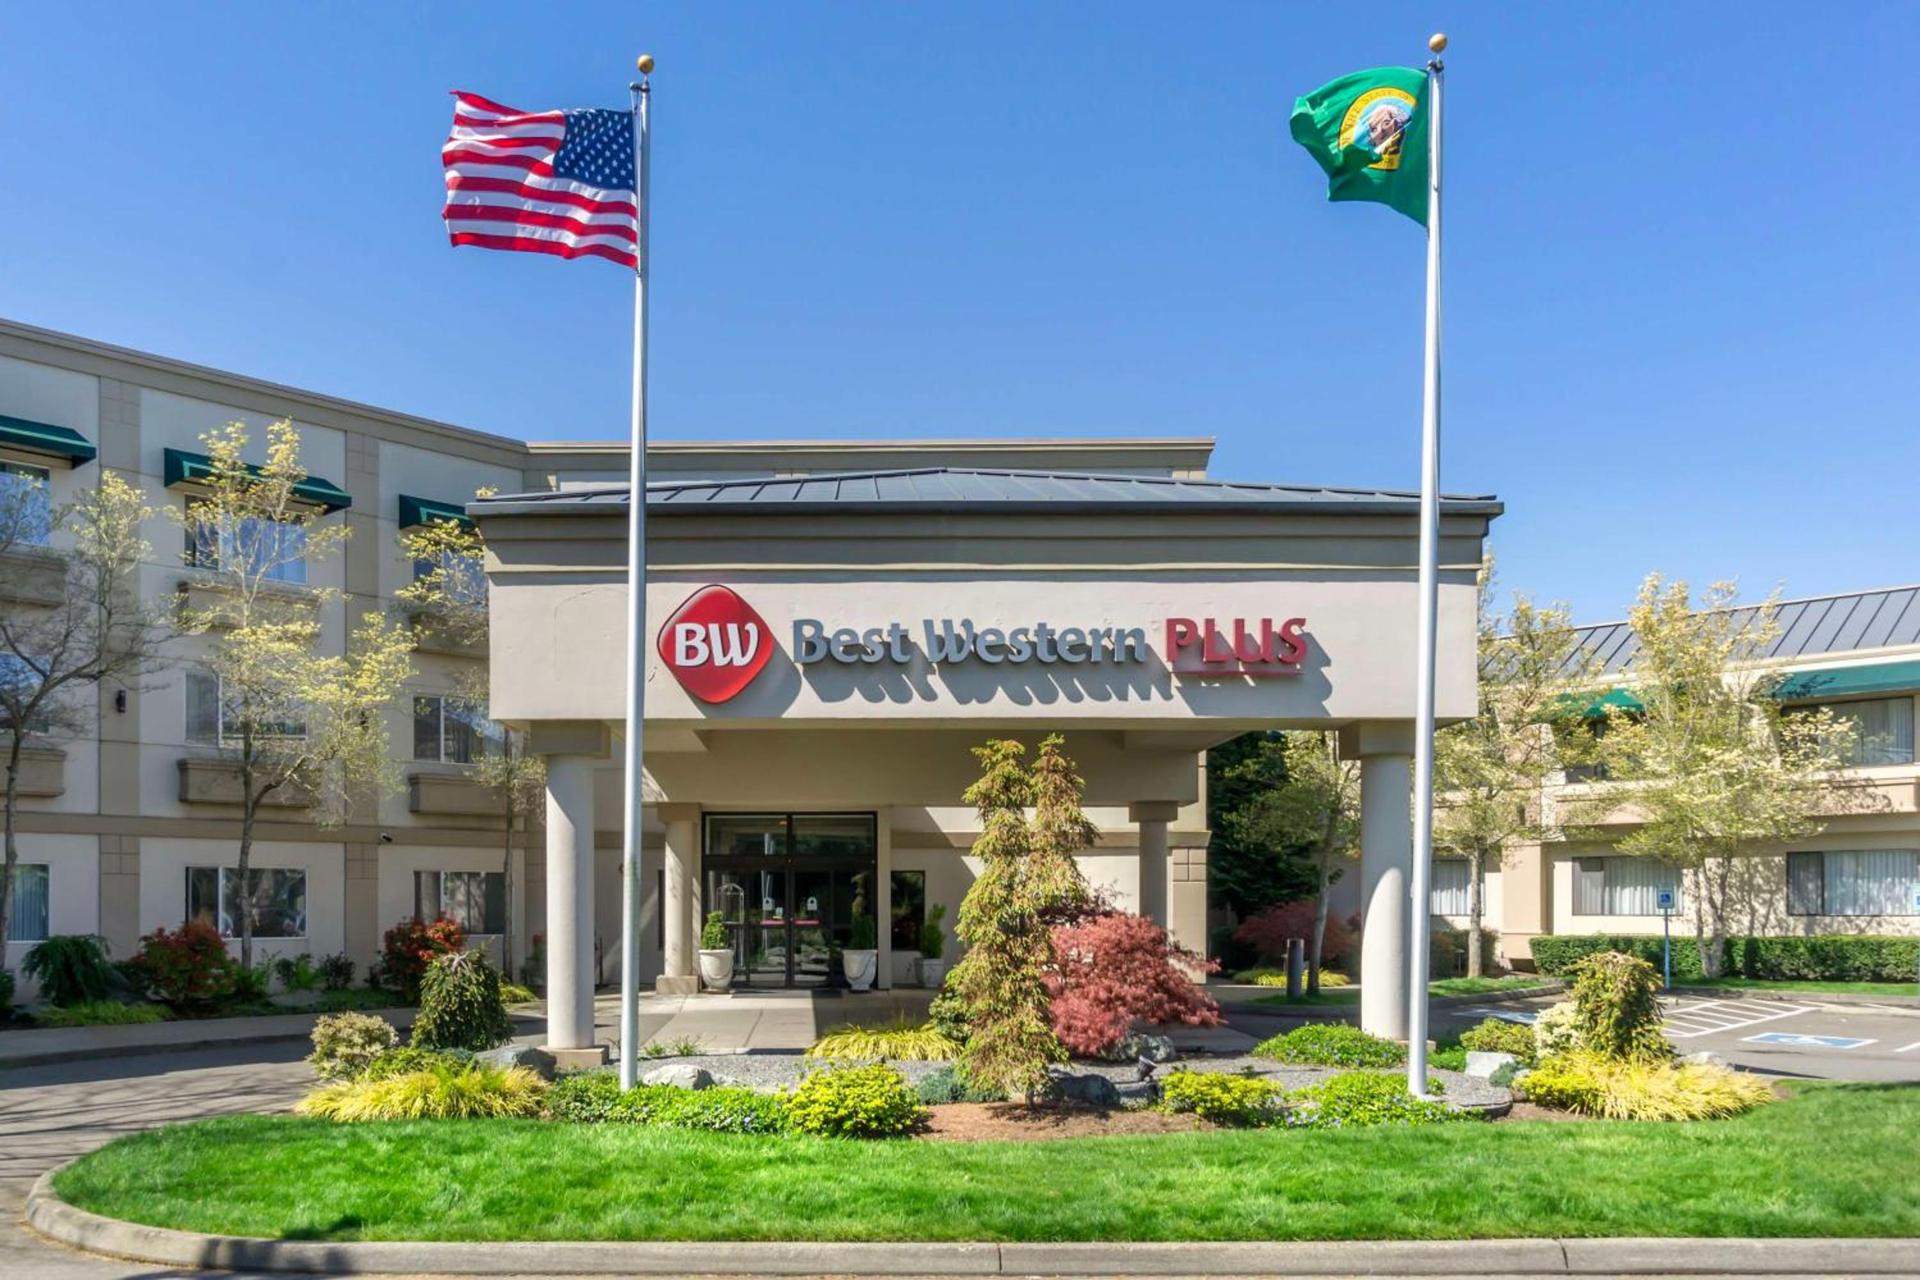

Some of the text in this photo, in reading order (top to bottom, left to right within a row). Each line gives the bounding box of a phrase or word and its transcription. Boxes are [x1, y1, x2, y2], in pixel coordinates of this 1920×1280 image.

[674, 622, 759, 667] BW
[793, 617, 1306, 664] Best Western PLUS
